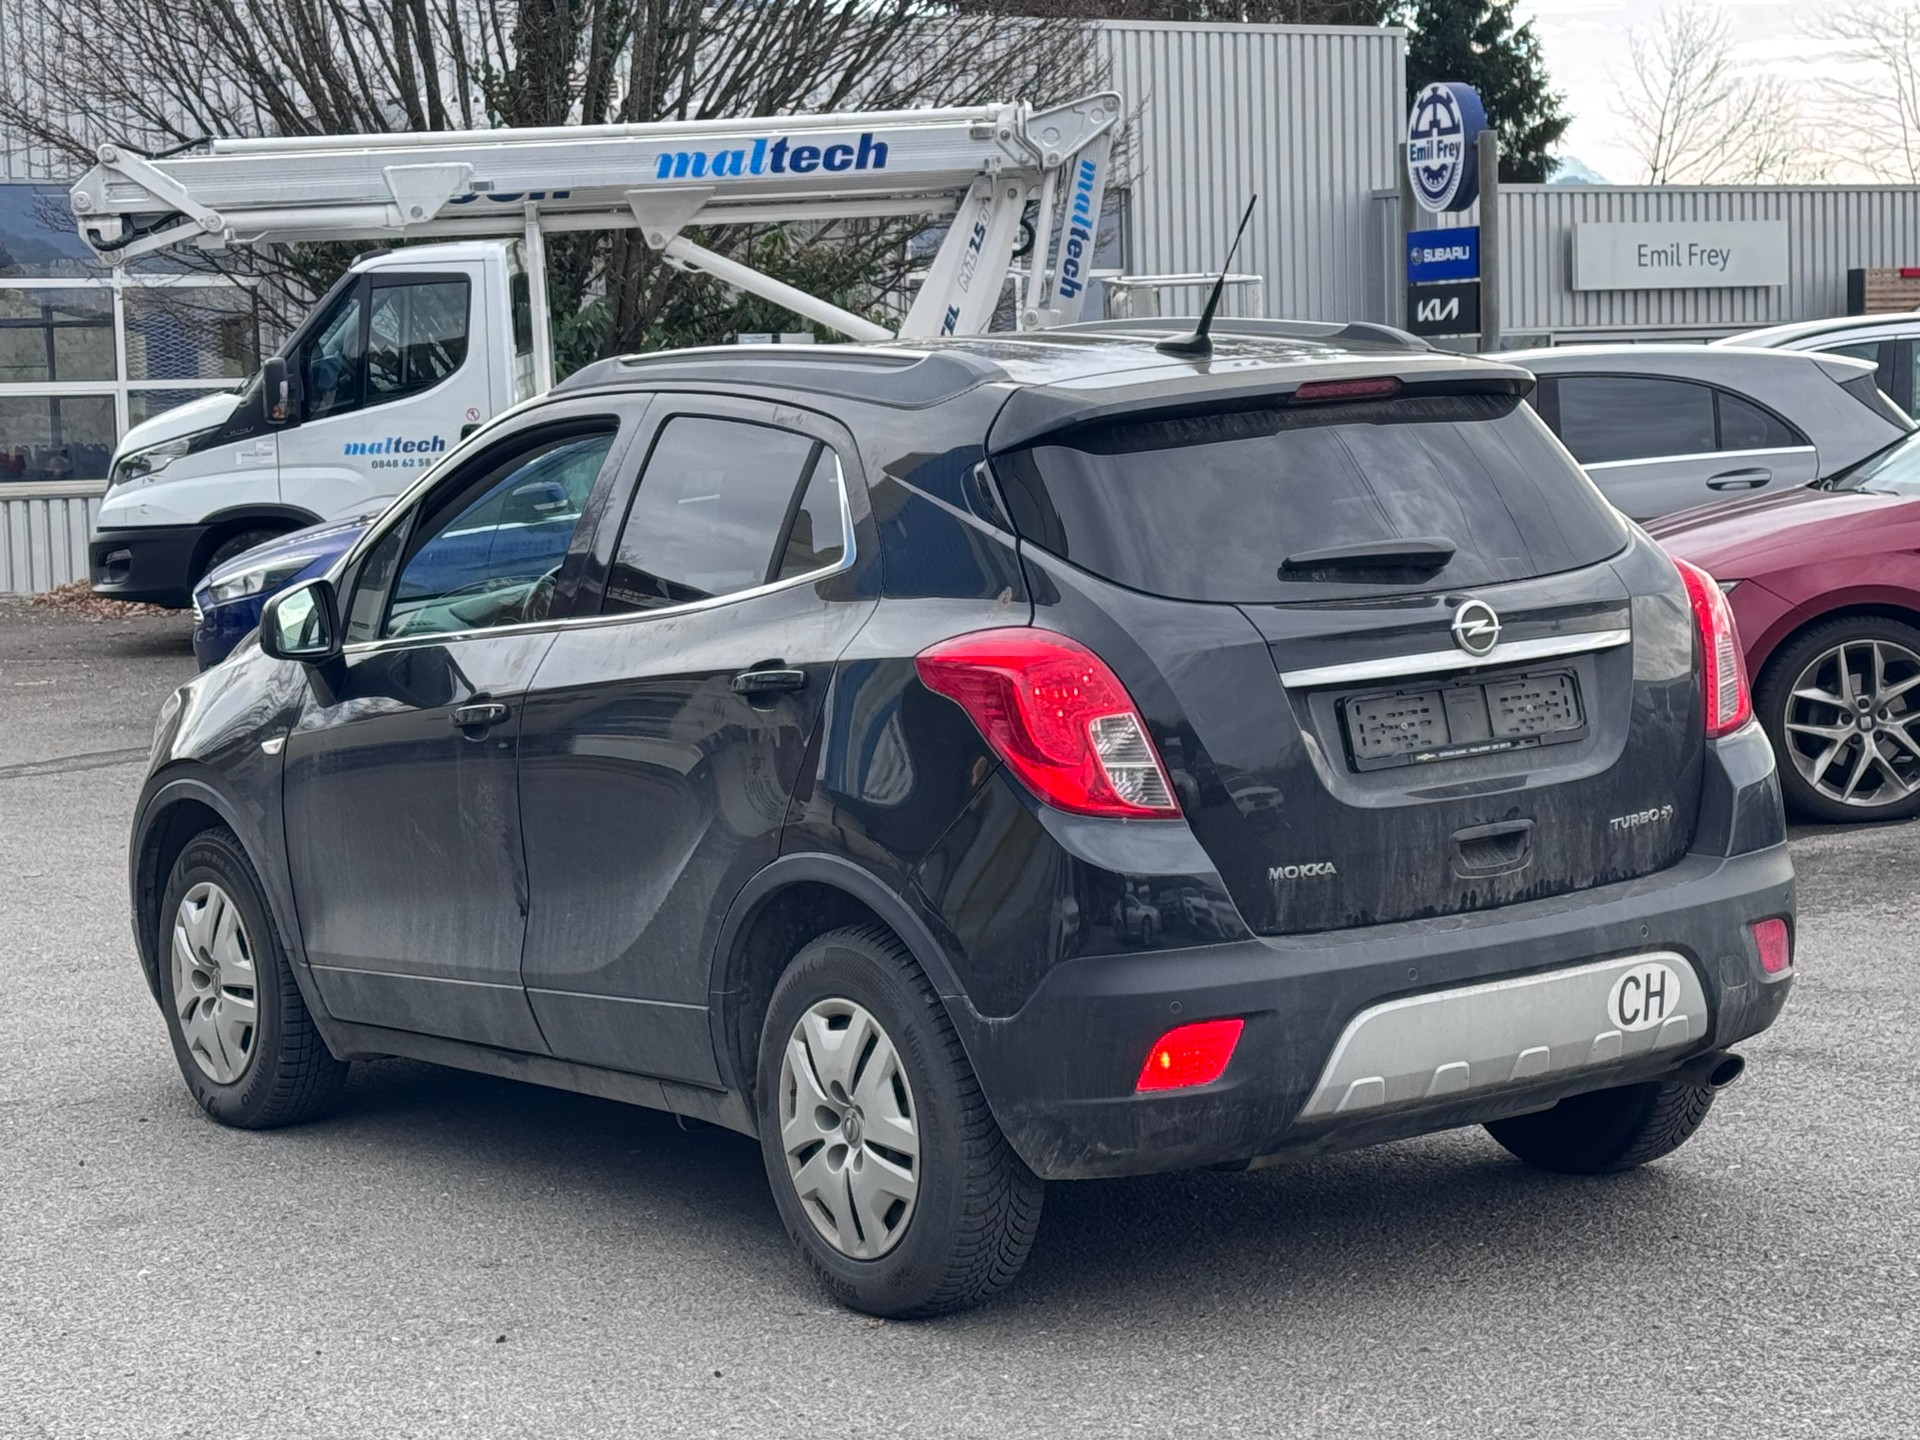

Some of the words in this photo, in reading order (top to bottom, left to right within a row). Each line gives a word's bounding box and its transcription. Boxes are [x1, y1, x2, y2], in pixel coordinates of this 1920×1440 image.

[654, 133, 889, 179] maltech
[1410, 140, 1433, 162] Emil
[1437, 139, 1461, 162] Frey
[1060, 159, 1097, 299] maltech
[1423, 245, 1470, 263] SUBARU
[1637, 242, 1682, 268] Emil
[1688, 243, 1731, 272] Frey
[1417, 297, 1459, 322] KIA
[343, 435, 446, 455] maltech
[371, 459, 398, 469] 0848
[401, 458, 415, 468] 62
[1609, 808, 1660, 831] TURBO
[1268, 861, 1337, 881] MOKKA
[1618, 970, 1666, 1026] CH
